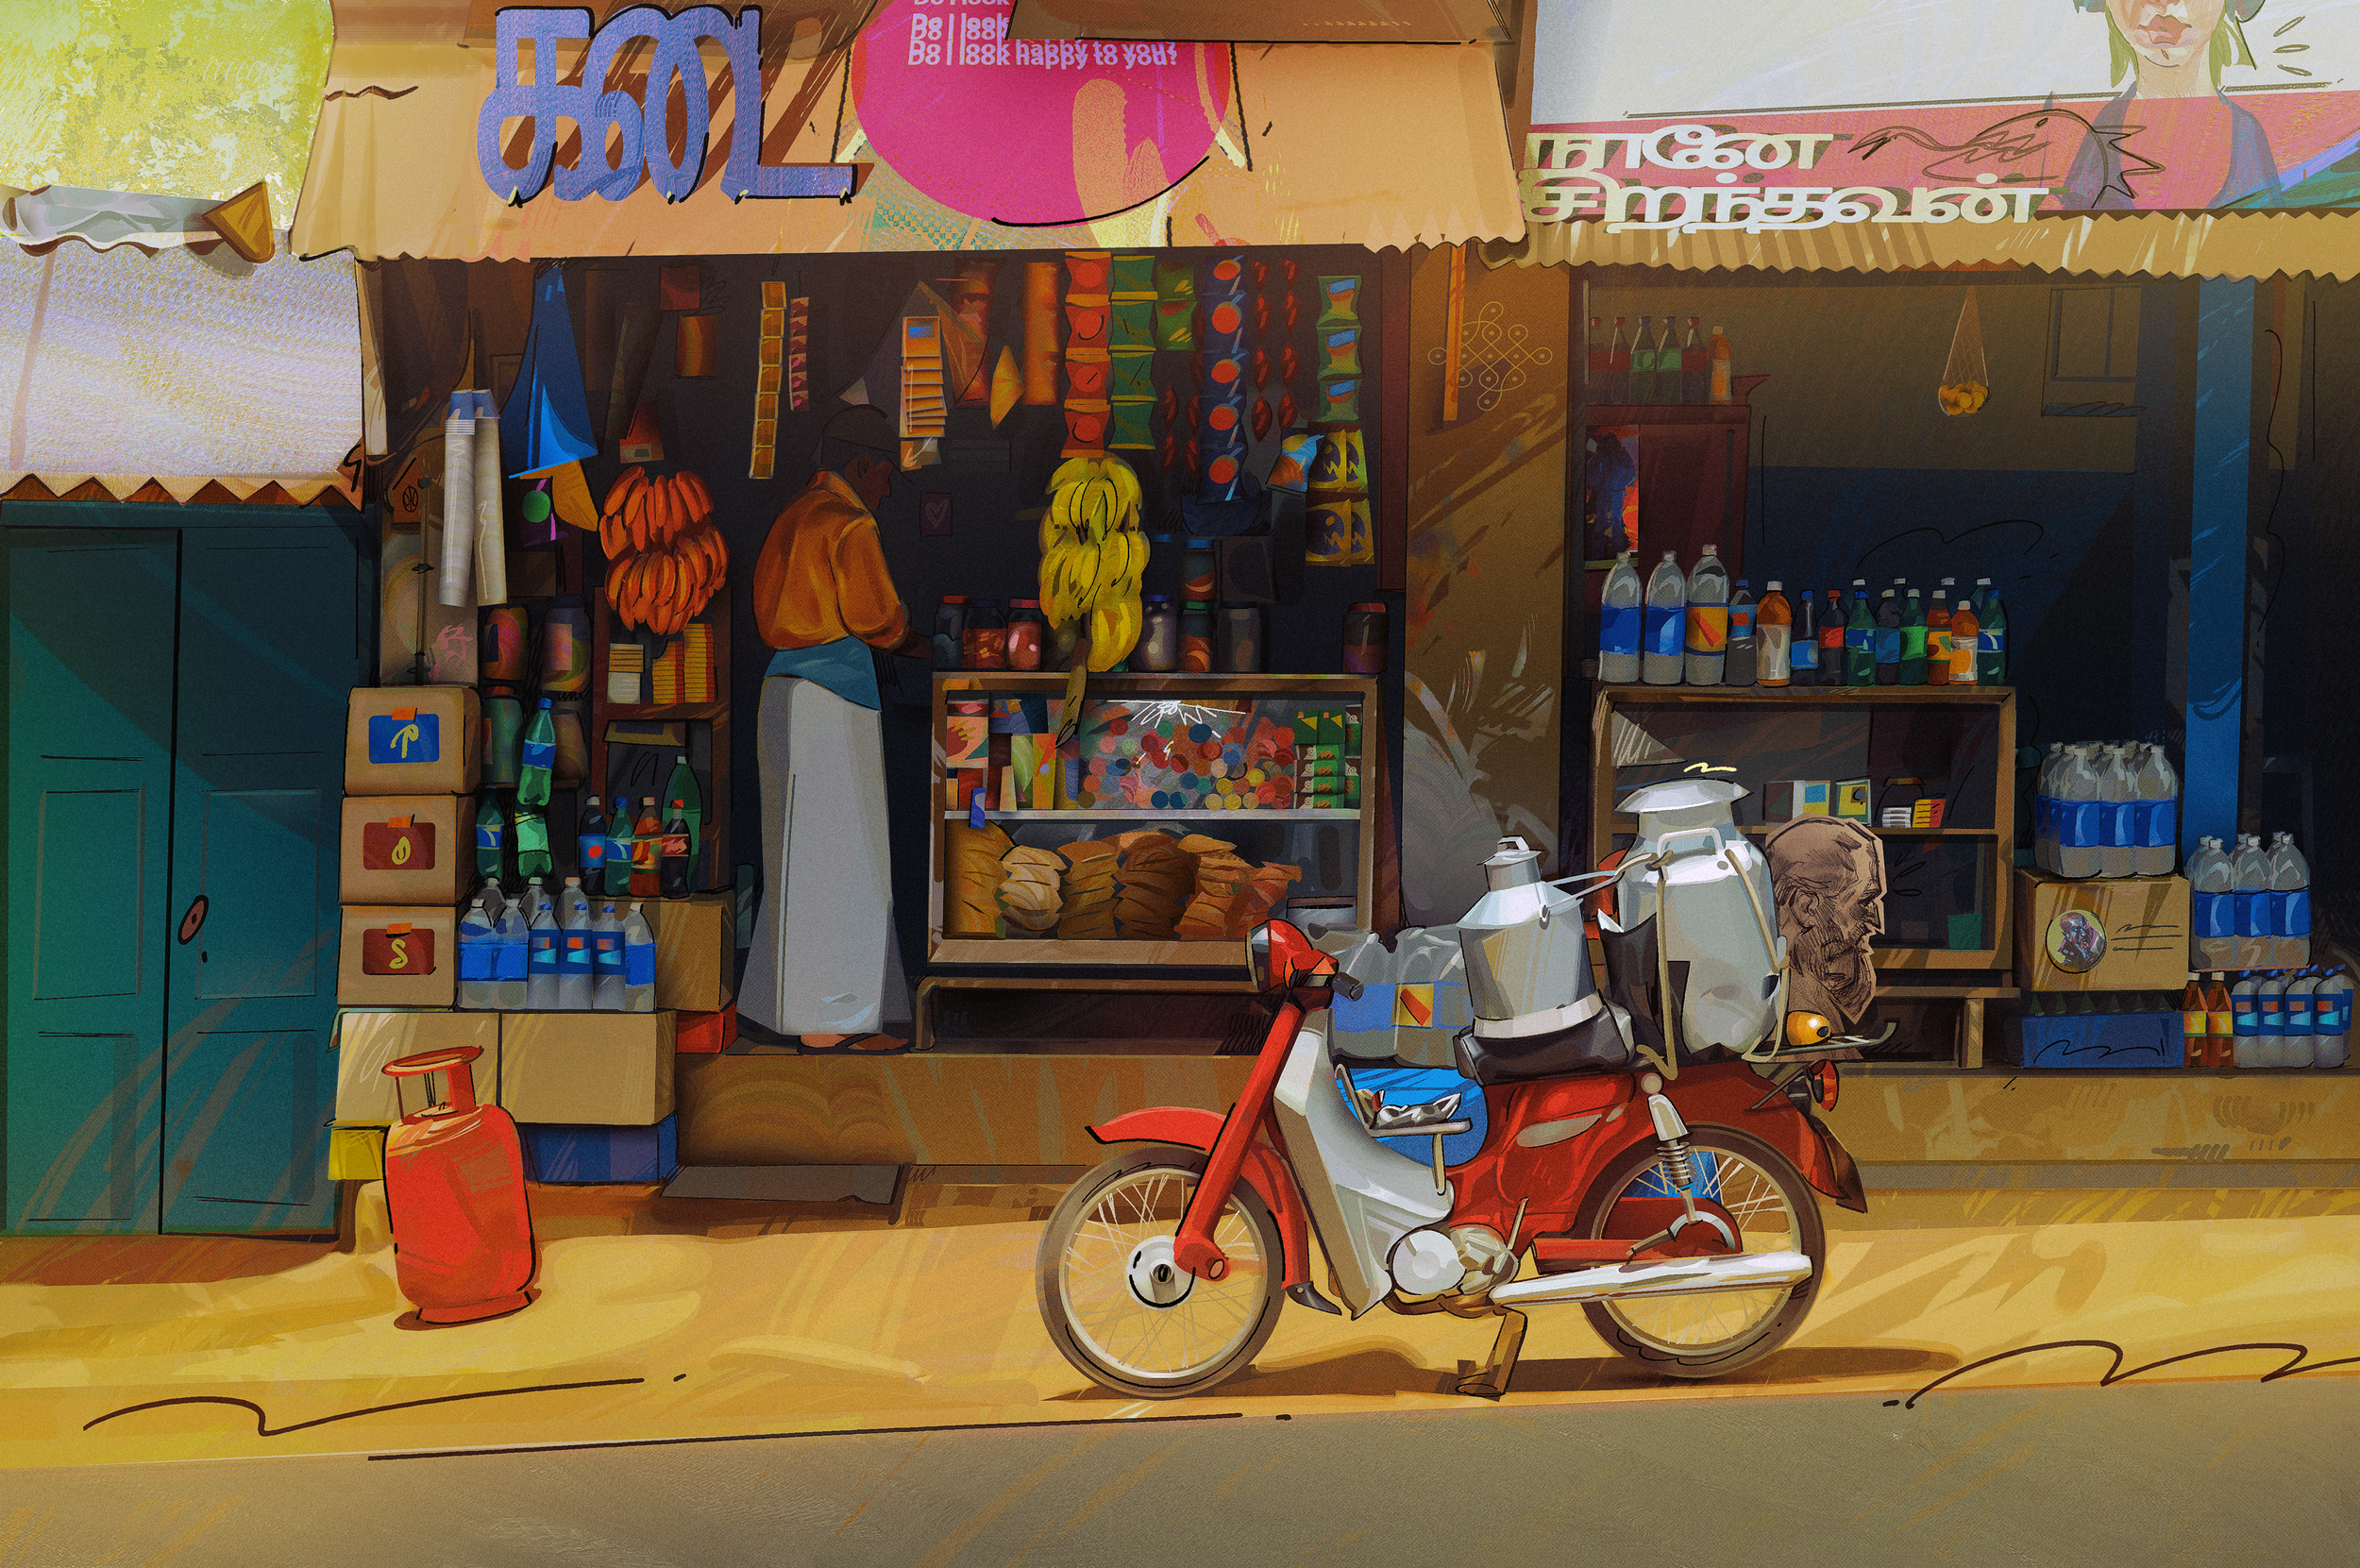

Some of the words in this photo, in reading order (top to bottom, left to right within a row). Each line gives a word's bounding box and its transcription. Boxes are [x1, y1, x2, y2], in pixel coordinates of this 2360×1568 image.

[477, 4, 857, 201] கடை
[1523, 124, 1834, 170] நானே
[1515, 168, 2049, 234] சிறந்தவன்
